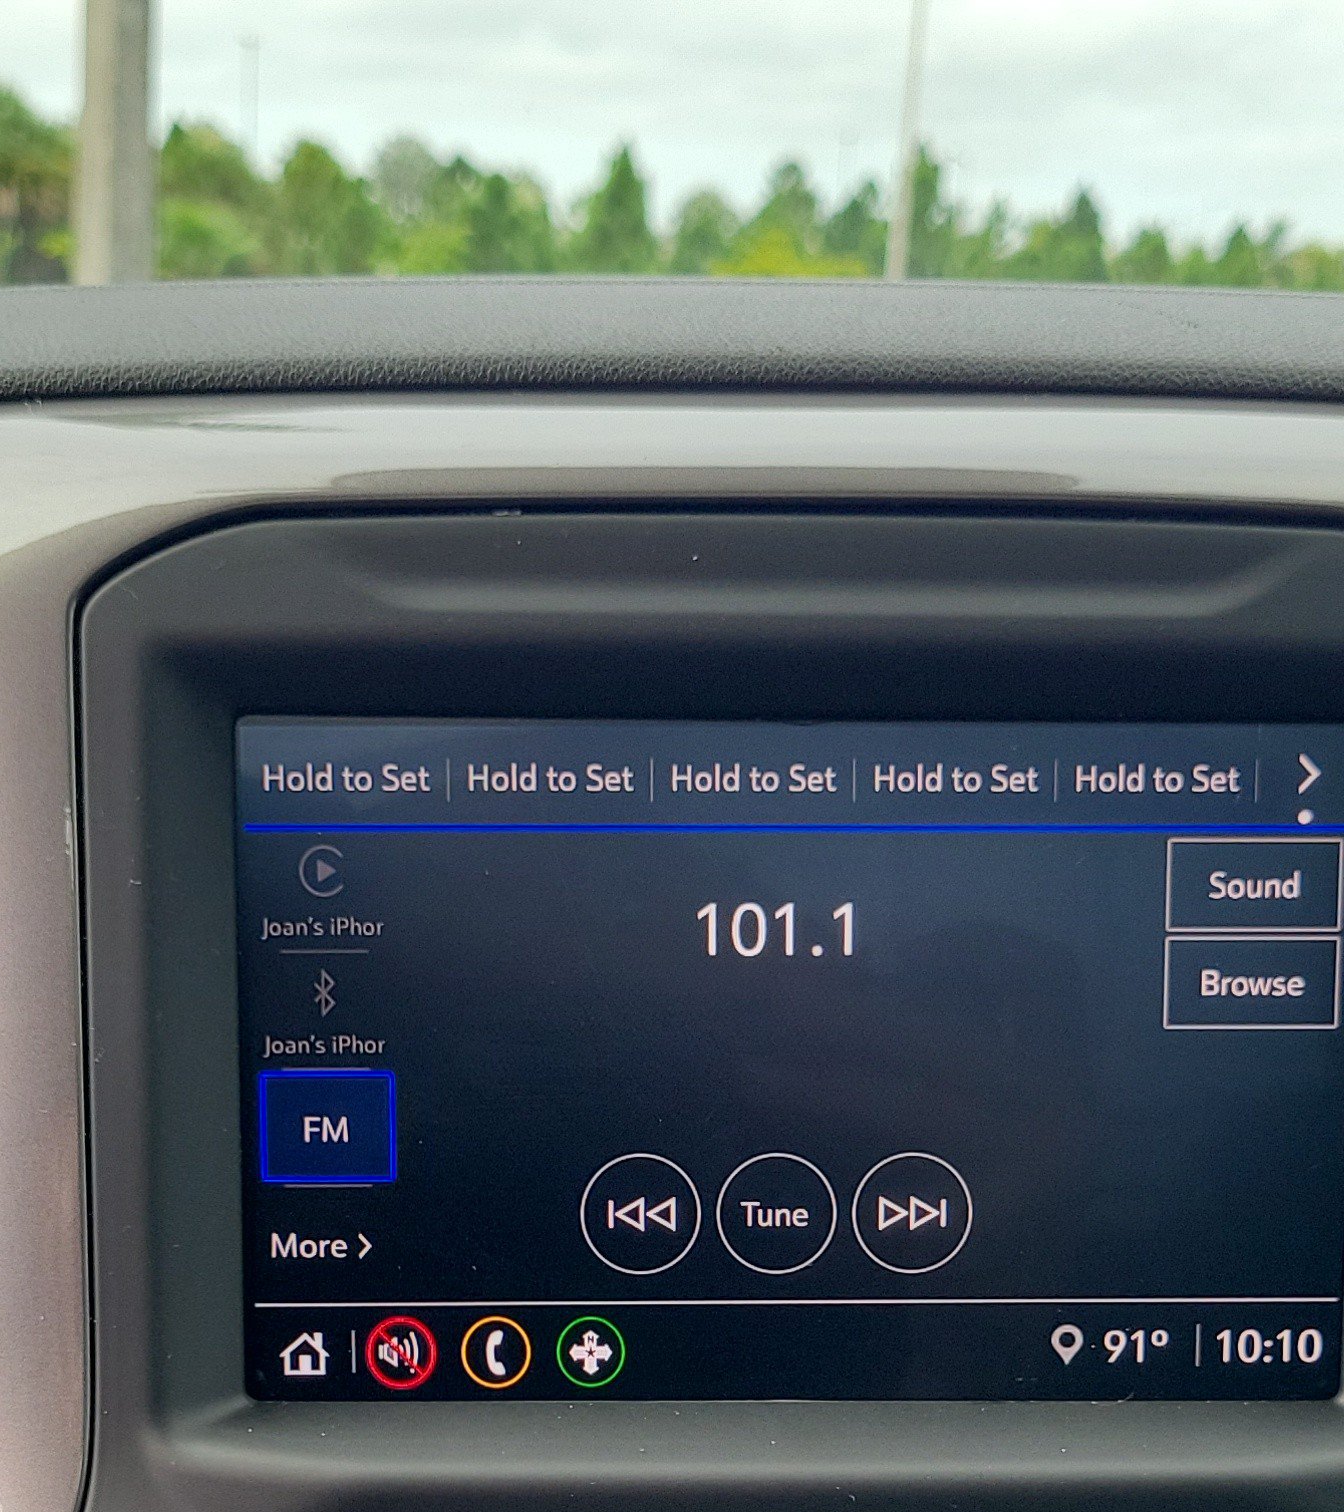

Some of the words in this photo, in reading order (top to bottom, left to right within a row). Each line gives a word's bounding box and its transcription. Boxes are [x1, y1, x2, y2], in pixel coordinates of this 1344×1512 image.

[263, 762, 333, 792] Hold
[341, 766, 373, 792] to
[381, 763, 431, 792] Set
[468, 762, 537, 792] Hold
[545, 766, 577, 792] to
[585, 763, 635, 792] Set
[671, 762, 741, 792] Hold
[748, 766, 780, 792] to
[788, 763, 838, 792] Set
[874, 762, 944, 793] Hold
[951, 766, 983, 793] to
[990, 763, 1039, 793] Set
[1075, 763, 1145, 793] Hold
[1152, 767, 1184, 793] to
[1191, 764, 1241, 793] Set
[1208, 870, 1301, 900] Sound
[261, 916, 324, 940] Joan's
[697, 901, 854, 957] 101.1
[1200, 969, 1306, 997] Browse
[263, 1034, 327, 1058] Joan's
[303, 1116, 349, 1143] FM
[739, 1201, 809, 1228] Tune
[271, 1232, 348, 1259] More
[1216, 1328, 1323, 1364] 10:10
